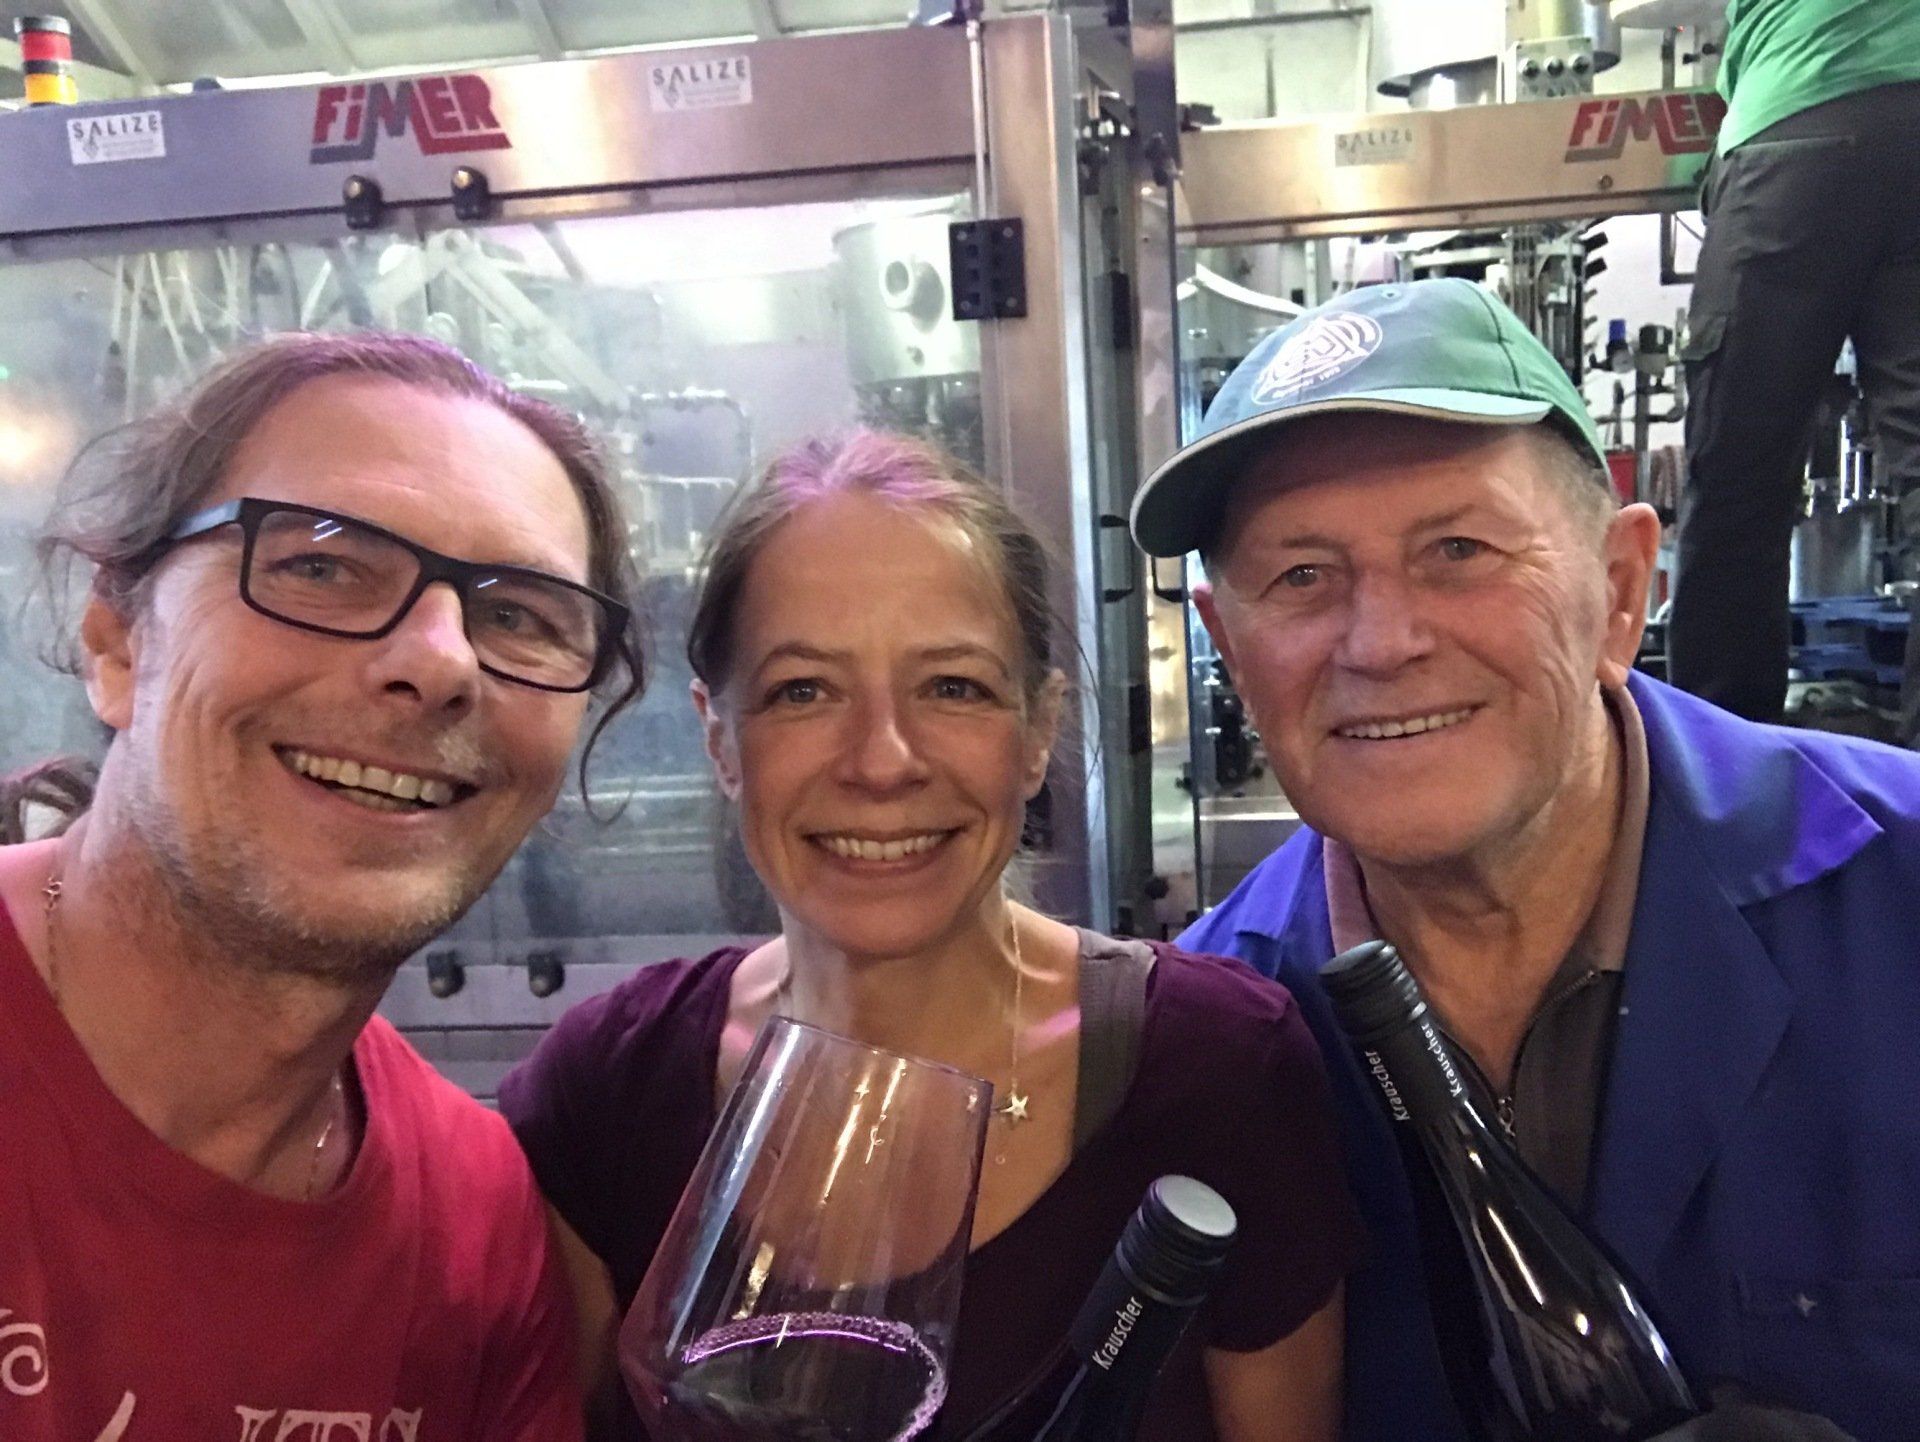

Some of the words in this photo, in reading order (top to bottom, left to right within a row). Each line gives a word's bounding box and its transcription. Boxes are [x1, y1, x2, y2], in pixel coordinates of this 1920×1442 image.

[653, 60, 746, 92] SALIZE
[72, 114, 158, 144] SALIZE
[1365, 1050, 1410, 1121] Krauscher
[1420, 1022, 1463, 1098] Krauscher
[1092, 1297, 1144, 1371] Krauscher
